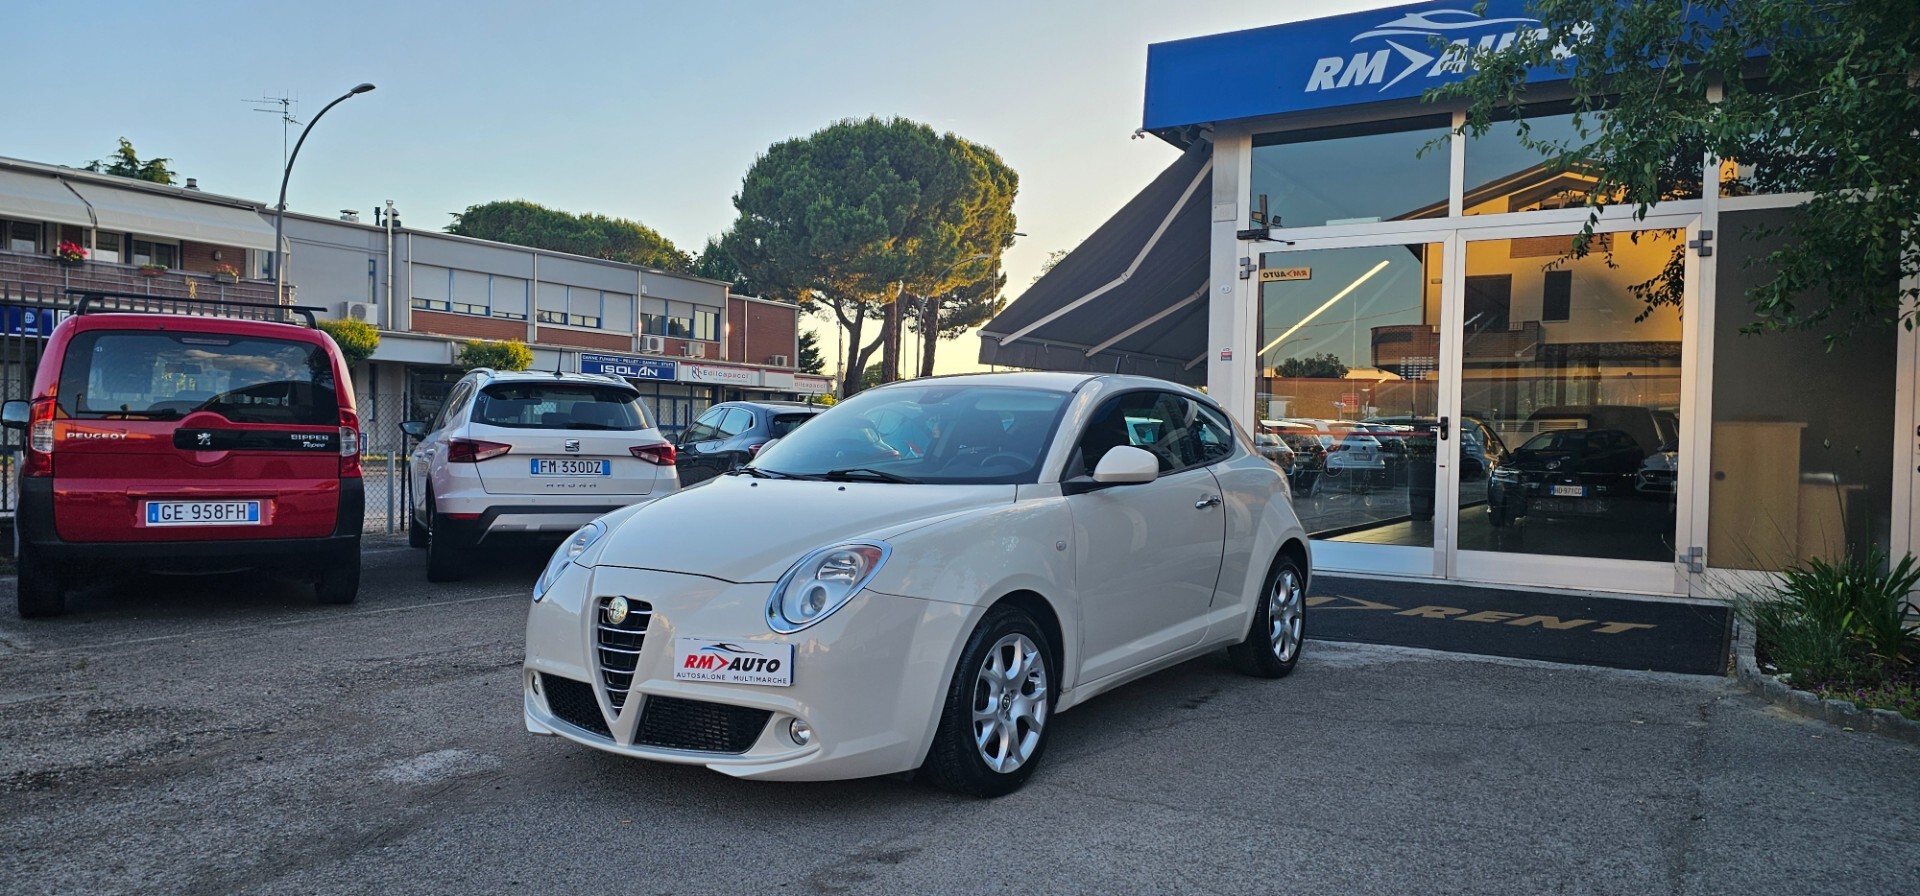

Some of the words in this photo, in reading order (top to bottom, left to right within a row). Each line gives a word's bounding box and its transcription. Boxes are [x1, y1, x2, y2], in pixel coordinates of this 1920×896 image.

[1304, 48, 1391, 93] RM
[600, 364, 658, 377] ISOLAN
[66, 432, 128, 440] PEUGEOT
[540, 460, 557, 473] FM
[561, 461, 602, 474] 330DZ
[161, 504, 184, 520] GE
[191, 504, 246, 520] 958FH
[1393, 605, 1658, 634] RENT
[684, 655, 715, 670] RM
[727, 657, 781, 674] AUTO
[676, 672, 726, 680] AUTOSALONE
[733, 676, 787, 684] MULTIMARCHE
